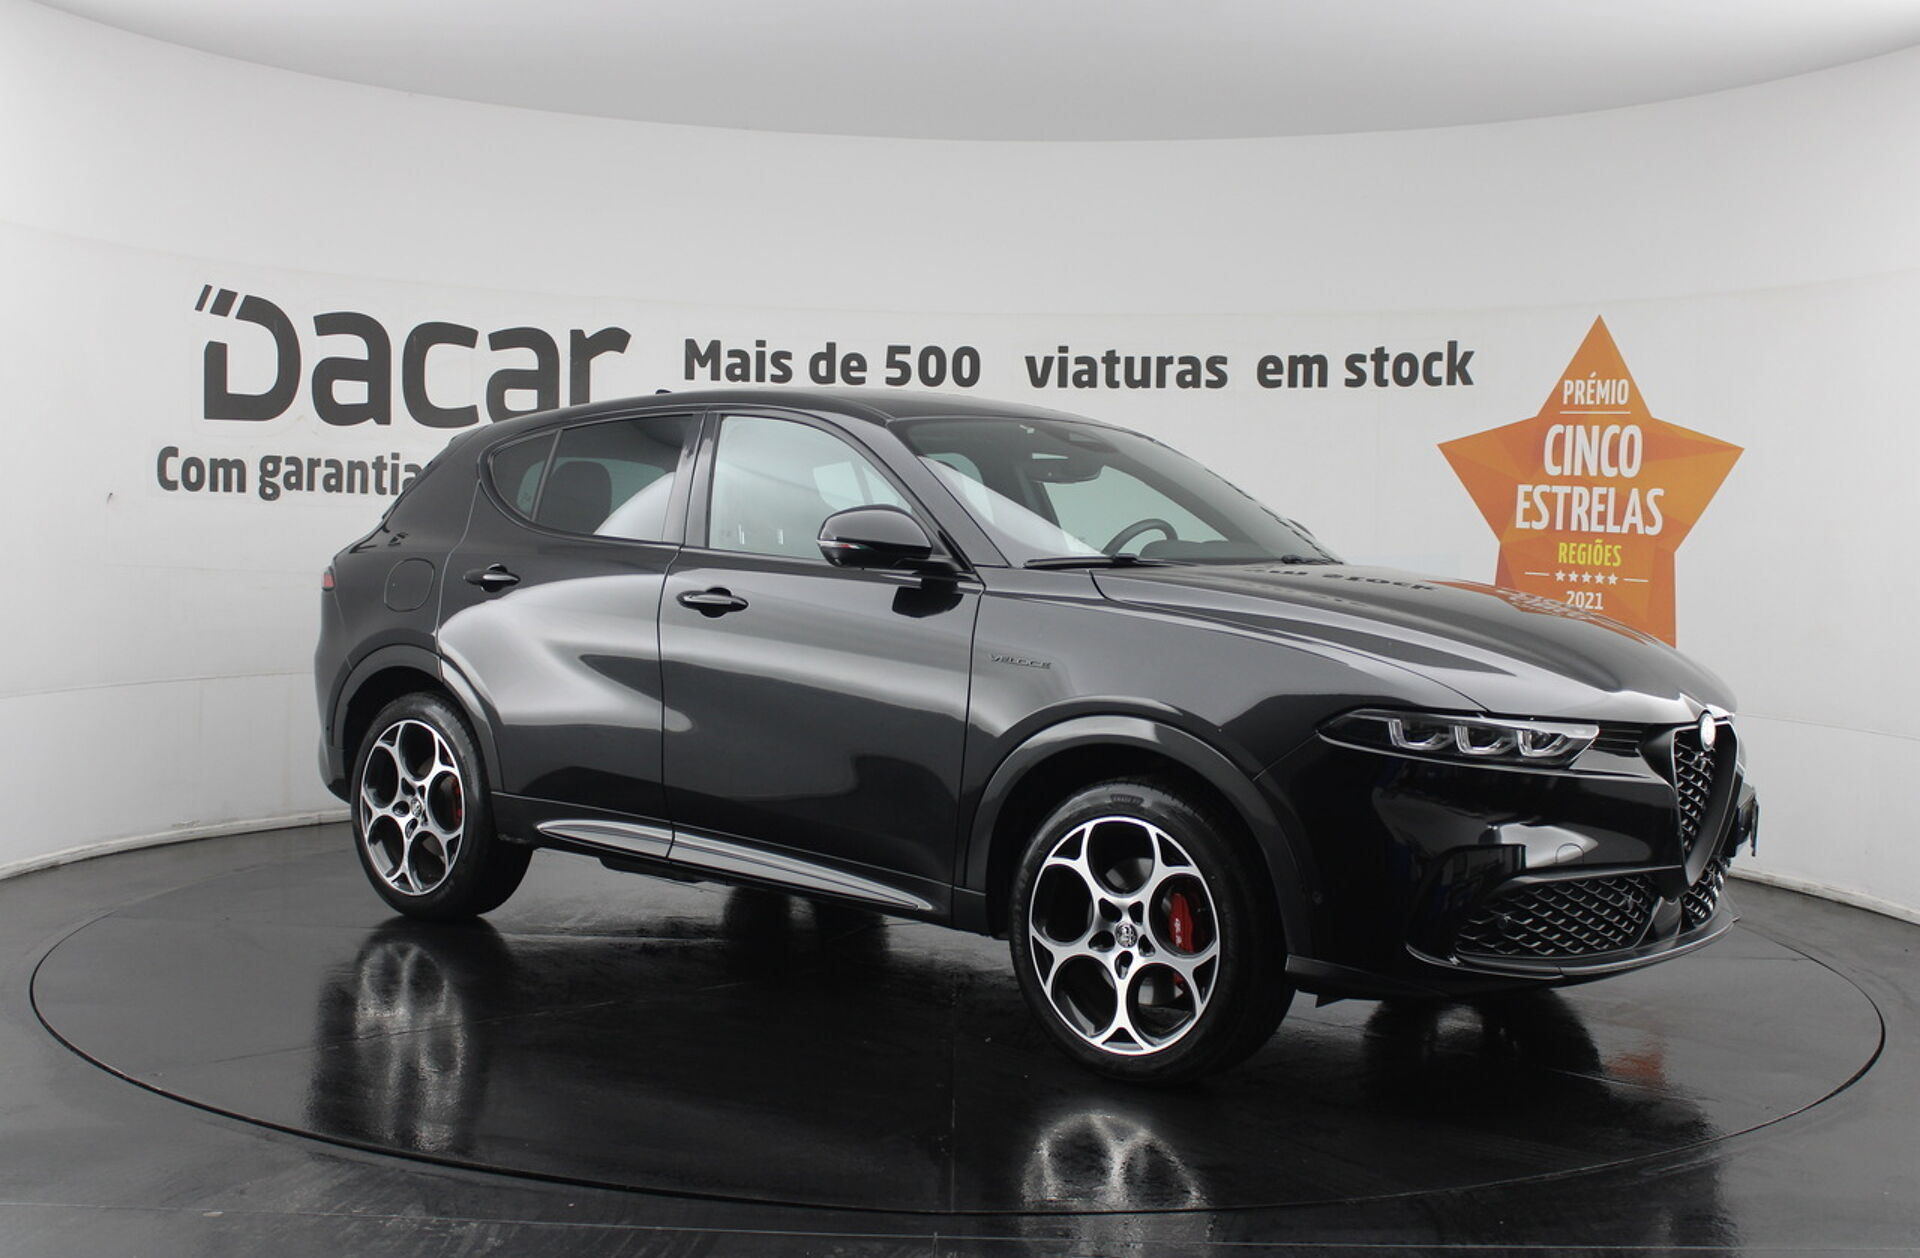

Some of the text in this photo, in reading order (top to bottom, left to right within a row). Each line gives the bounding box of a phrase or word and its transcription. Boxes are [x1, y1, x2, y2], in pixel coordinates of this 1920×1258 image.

[194, 284, 632, 428] Dacar
[684, 338, 1475, 389] Mais de 500 viaturas em stock
[1562, 371, 1631, 406] PRÉMIO
[156, 446, 247, 494] Com
[1543, 423, 1644, 479] CINCO
[1515, 484, 1665, 536] ESTRELAS
[1557, 538, 1623, 568] REGIÕES
[1566, 590, 1604, 611] 2021
